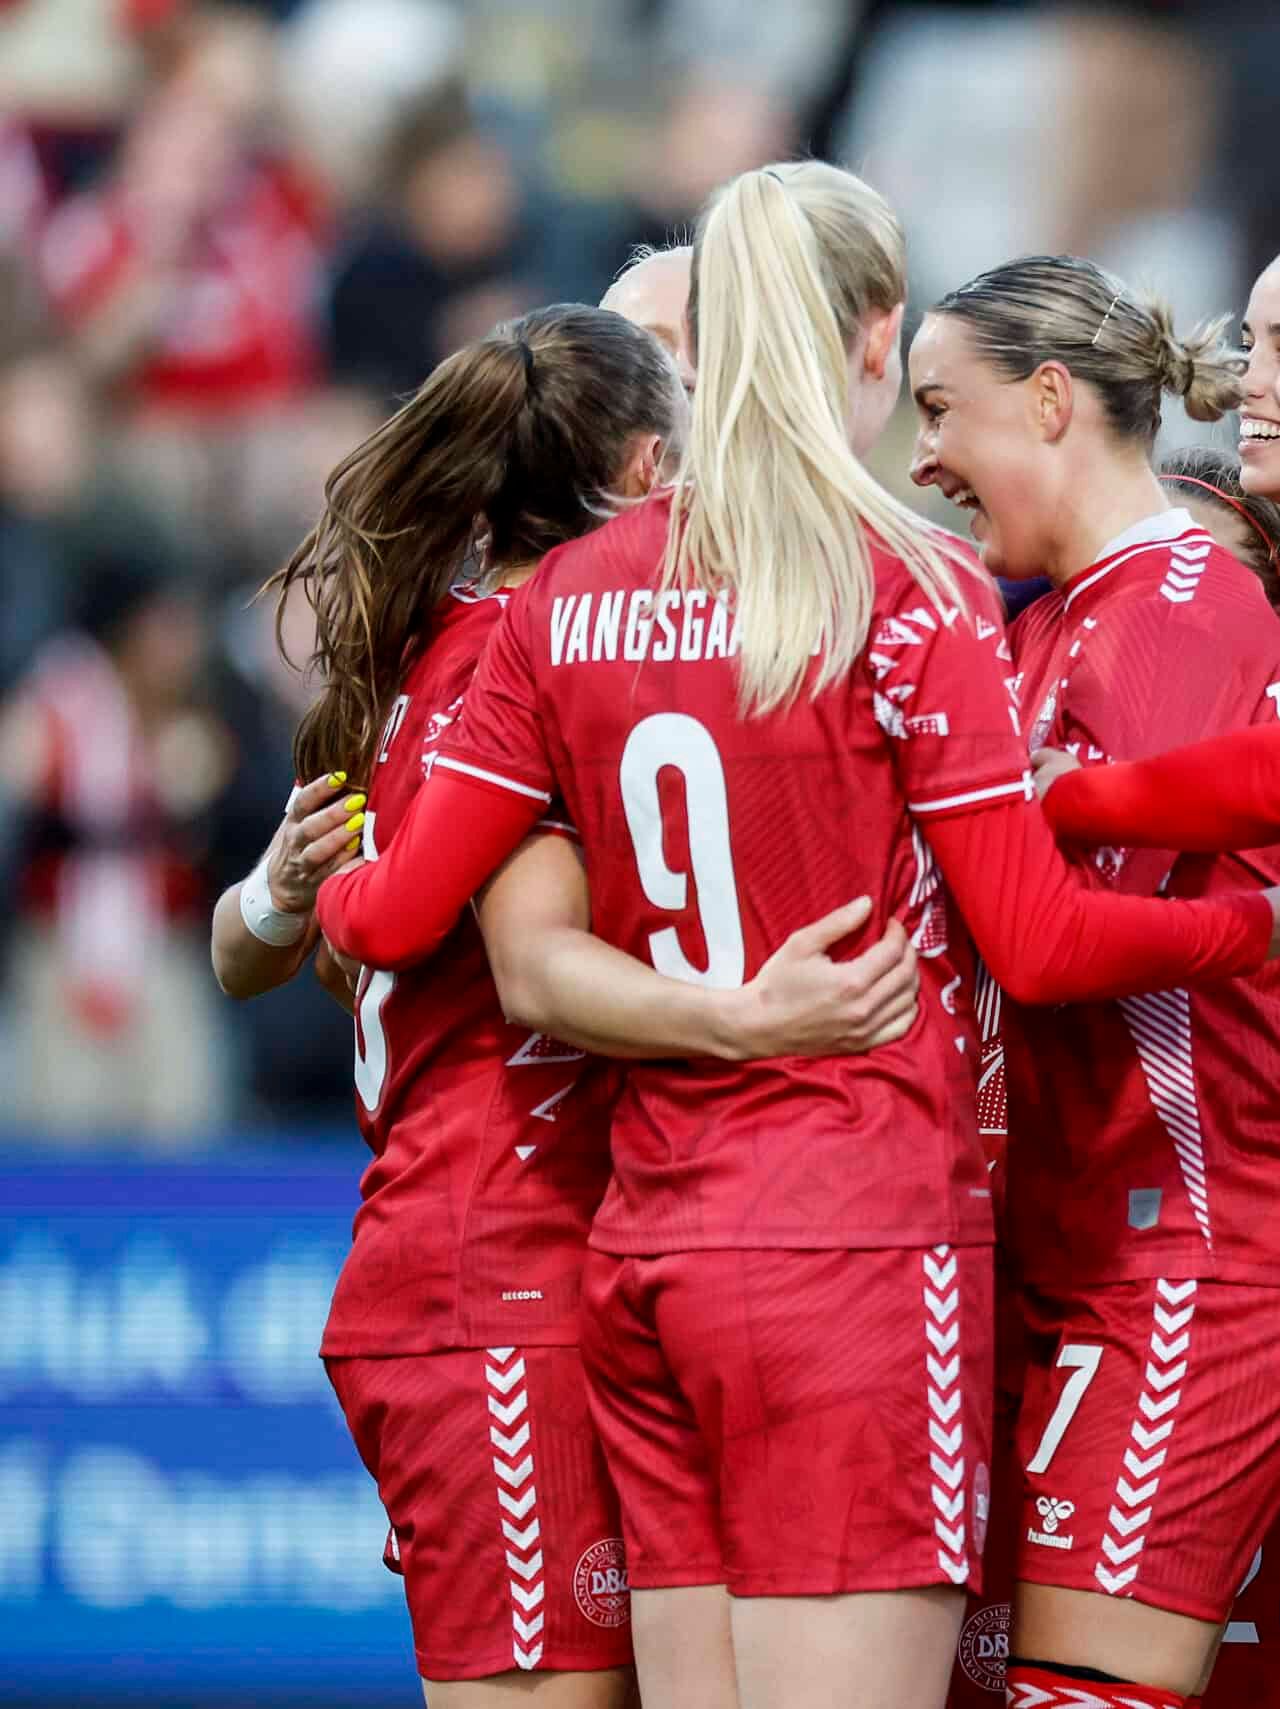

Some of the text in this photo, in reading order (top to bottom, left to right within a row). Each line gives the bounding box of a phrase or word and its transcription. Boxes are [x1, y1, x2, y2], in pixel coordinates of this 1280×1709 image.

[550, 589, 823, 666] VANGSGA
[619, 711, 745, 989] 9
[1026, 1344, 1104, 1473] 7
[1027, 1527, 1073, 1550] hummel
